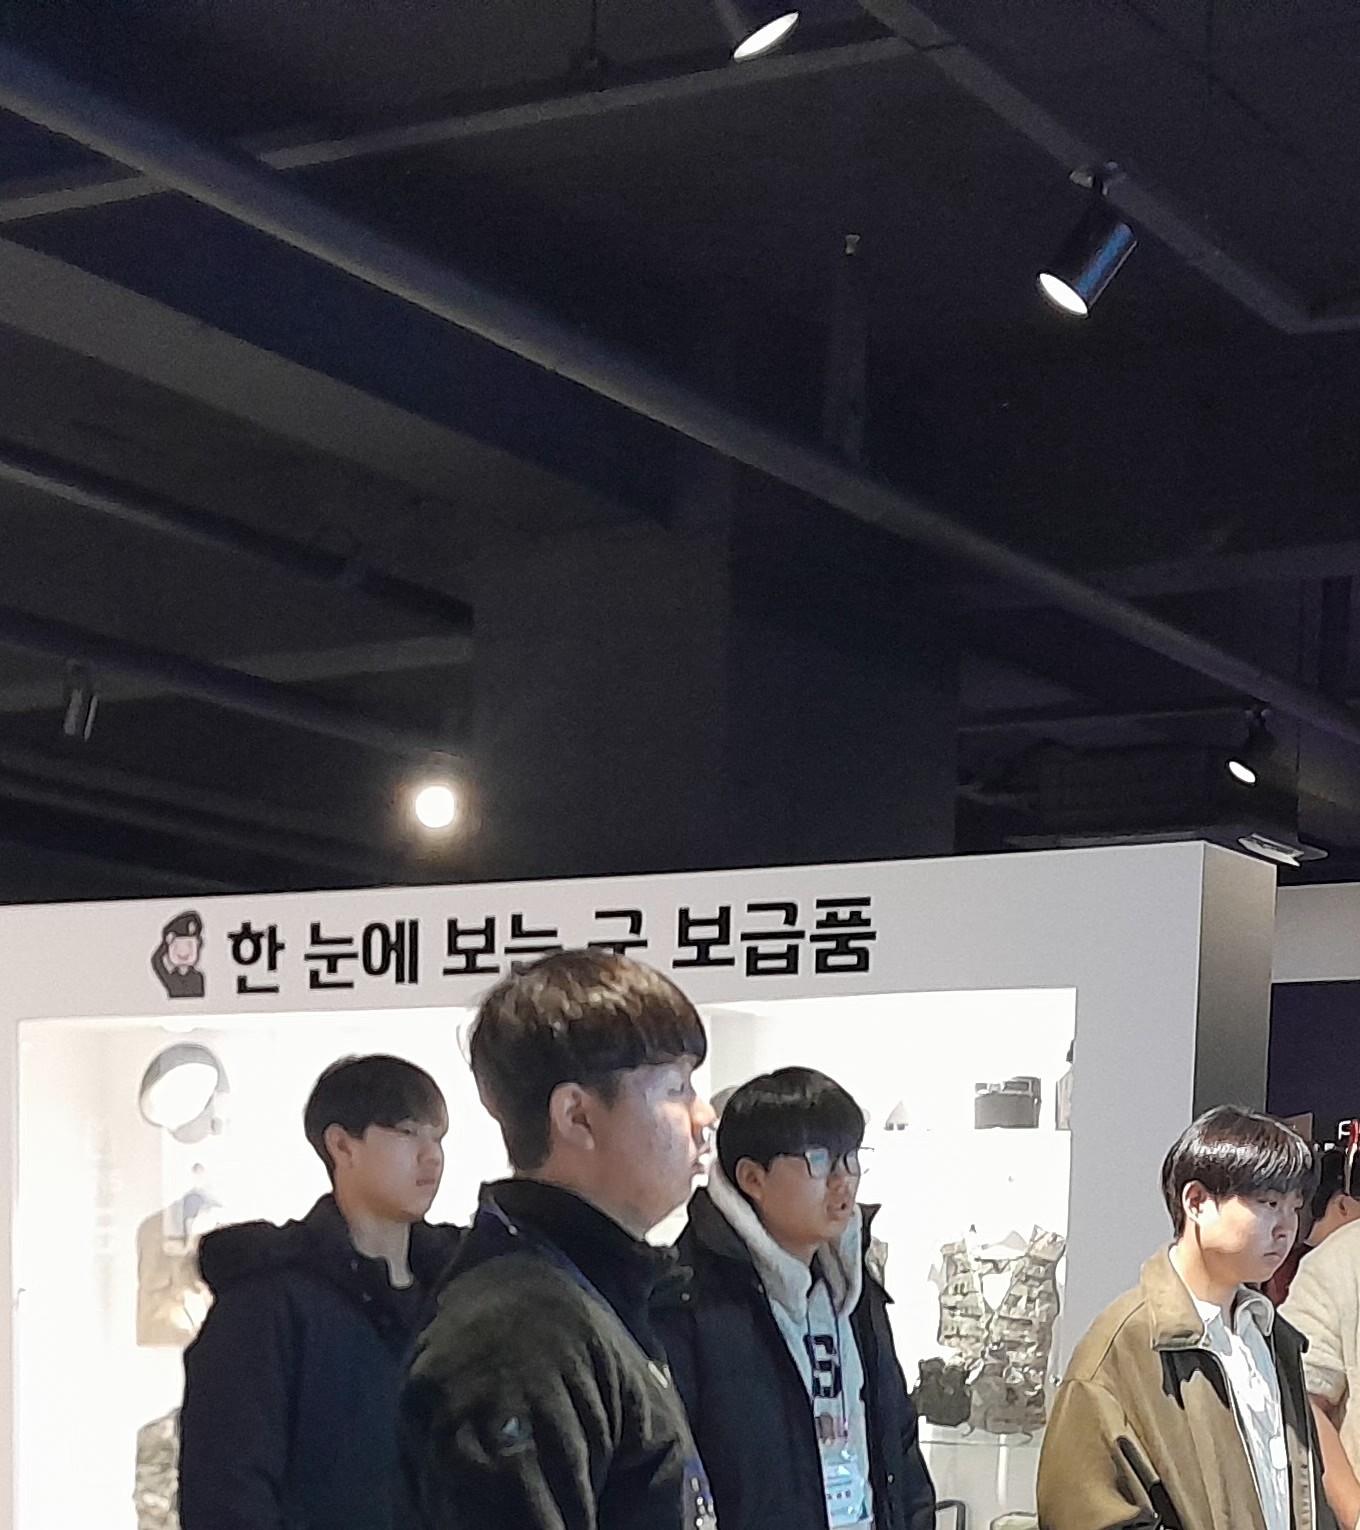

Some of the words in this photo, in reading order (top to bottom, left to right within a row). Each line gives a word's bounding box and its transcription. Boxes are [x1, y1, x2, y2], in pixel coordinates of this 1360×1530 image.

[227, 920, 286, 995] 한
[303, 918, 420, 989] 눈에
[443, 912, 564, 977] 보는
[672, 896, 877, 977] 보급품
